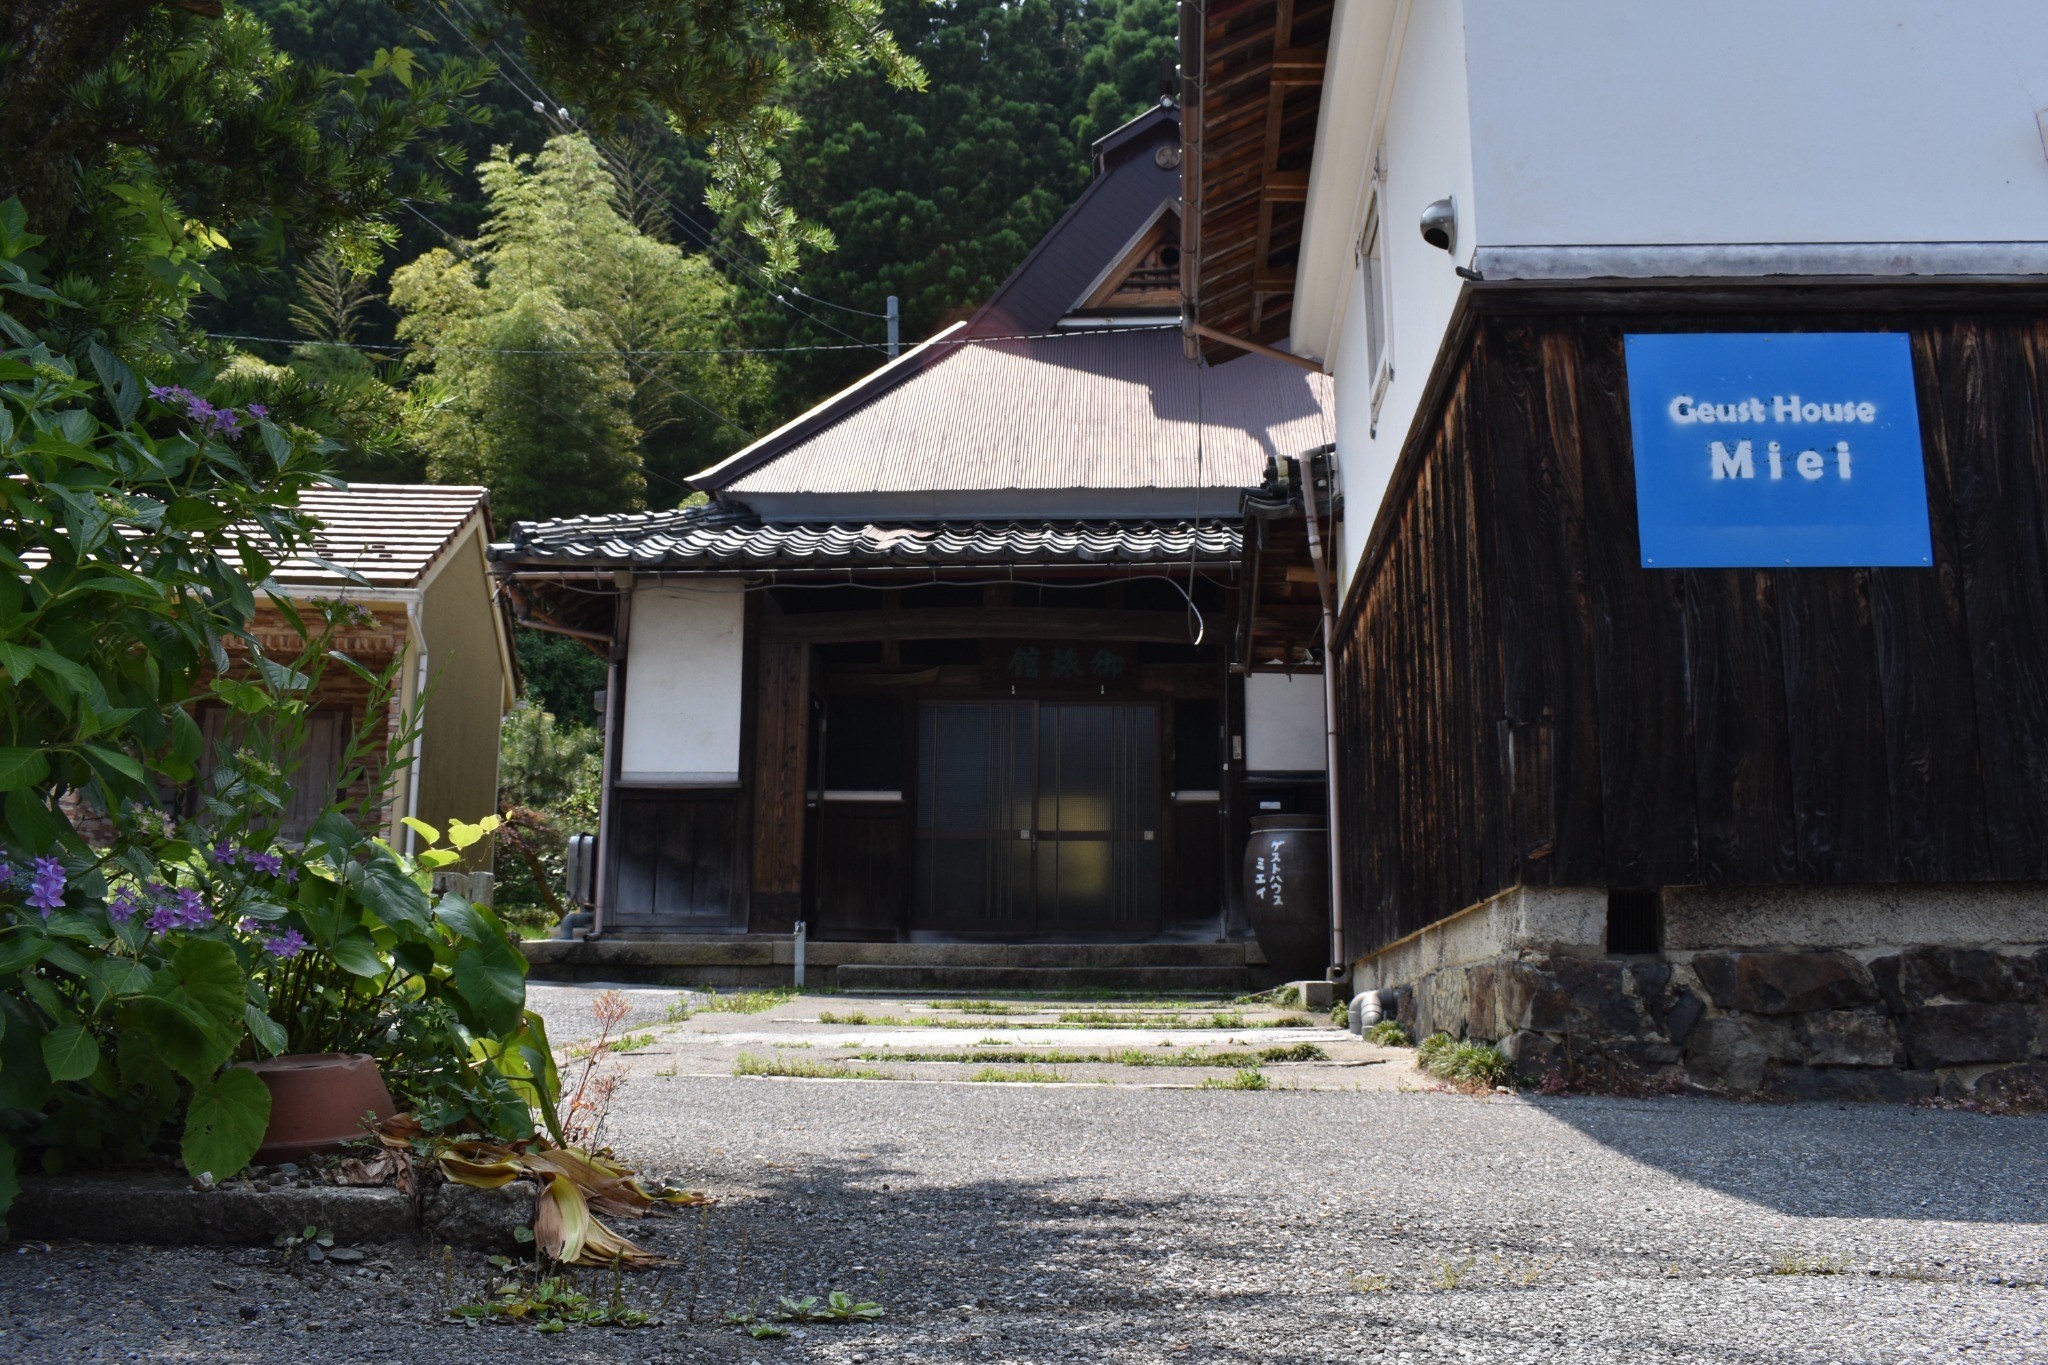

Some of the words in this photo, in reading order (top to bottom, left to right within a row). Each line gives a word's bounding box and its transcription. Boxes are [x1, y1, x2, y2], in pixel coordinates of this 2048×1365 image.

[1670, 395, 1764, 423] Geust
[1774, 395, 1875, 422] House
[1712, 441, 1850, 479] Miei
[1255, 857, 1266, 899] ミエイ
[1270, 840, 1285, 905] ゲストハウス
